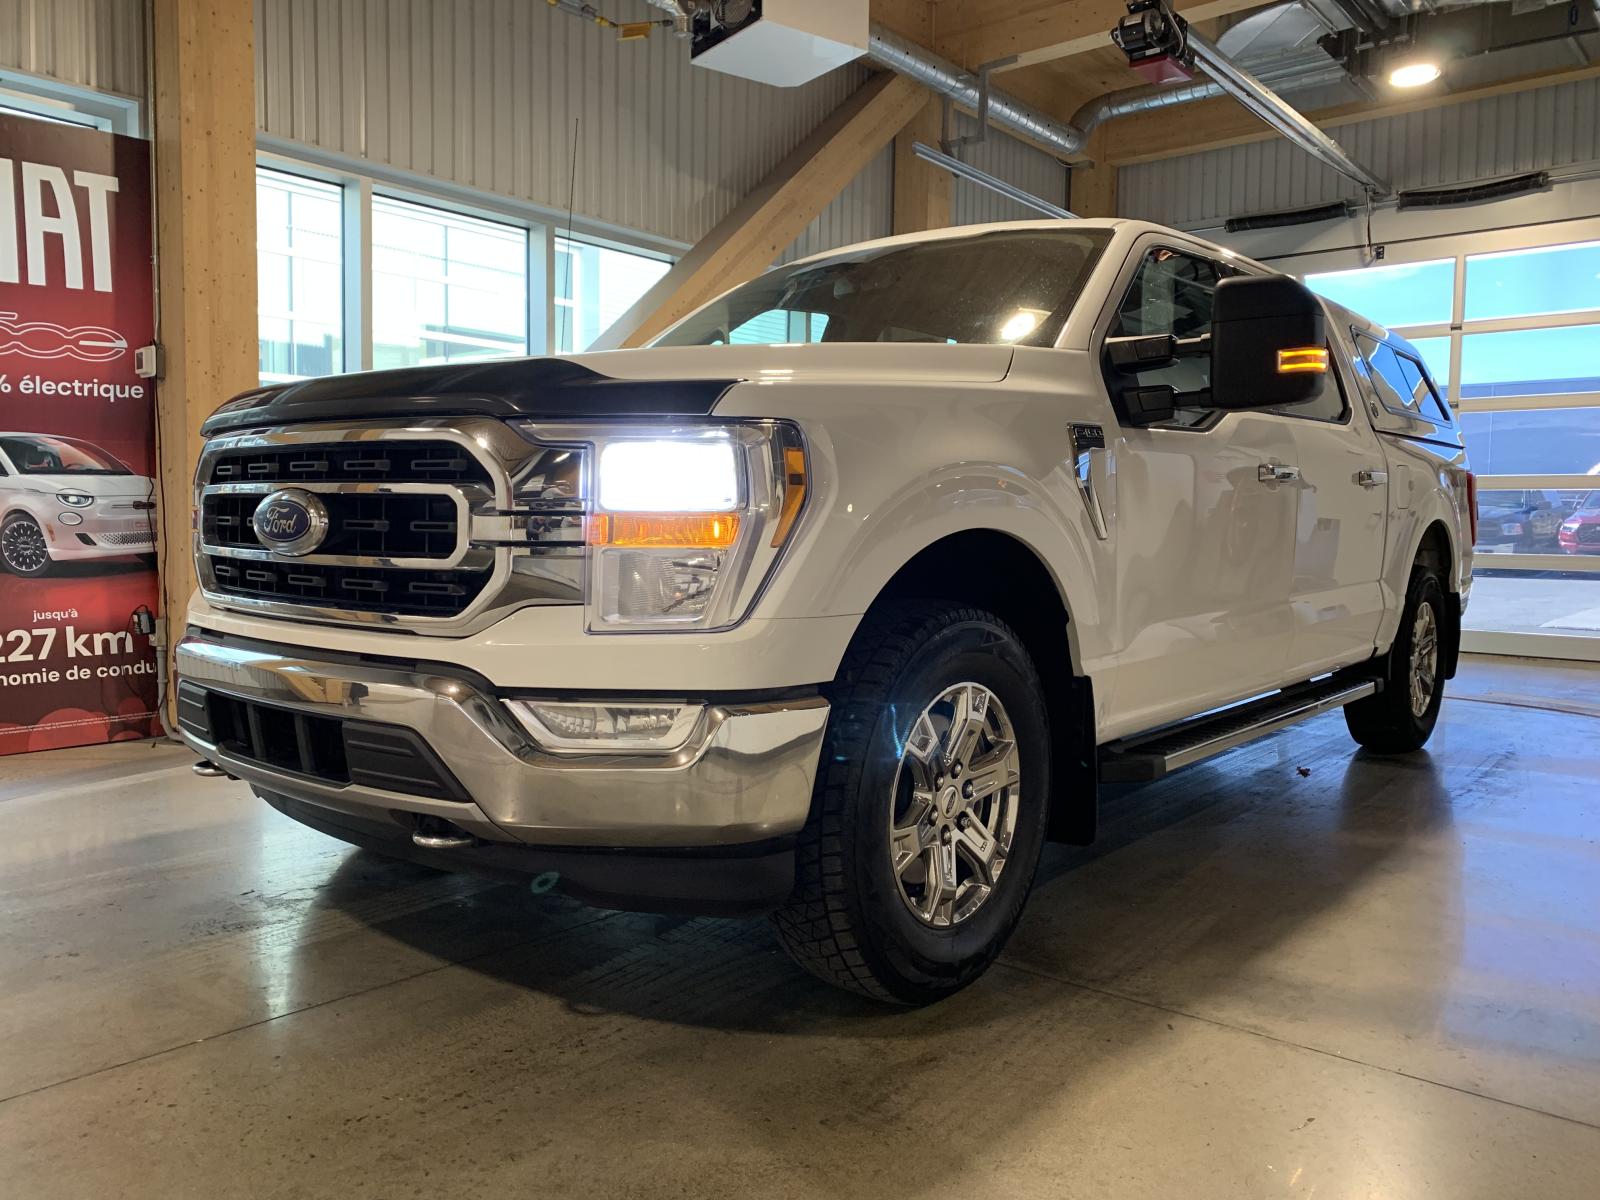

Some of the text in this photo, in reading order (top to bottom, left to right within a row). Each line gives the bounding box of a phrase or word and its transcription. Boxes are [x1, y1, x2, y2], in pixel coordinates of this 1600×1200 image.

[19, 374, 144, 403] électrique
[263, 506, 298, 534] Ford
[32, 608, 78, 622] jusqu'à
[0, 625, 134, 663] 27 km
[65, 665, 91, 681] de
